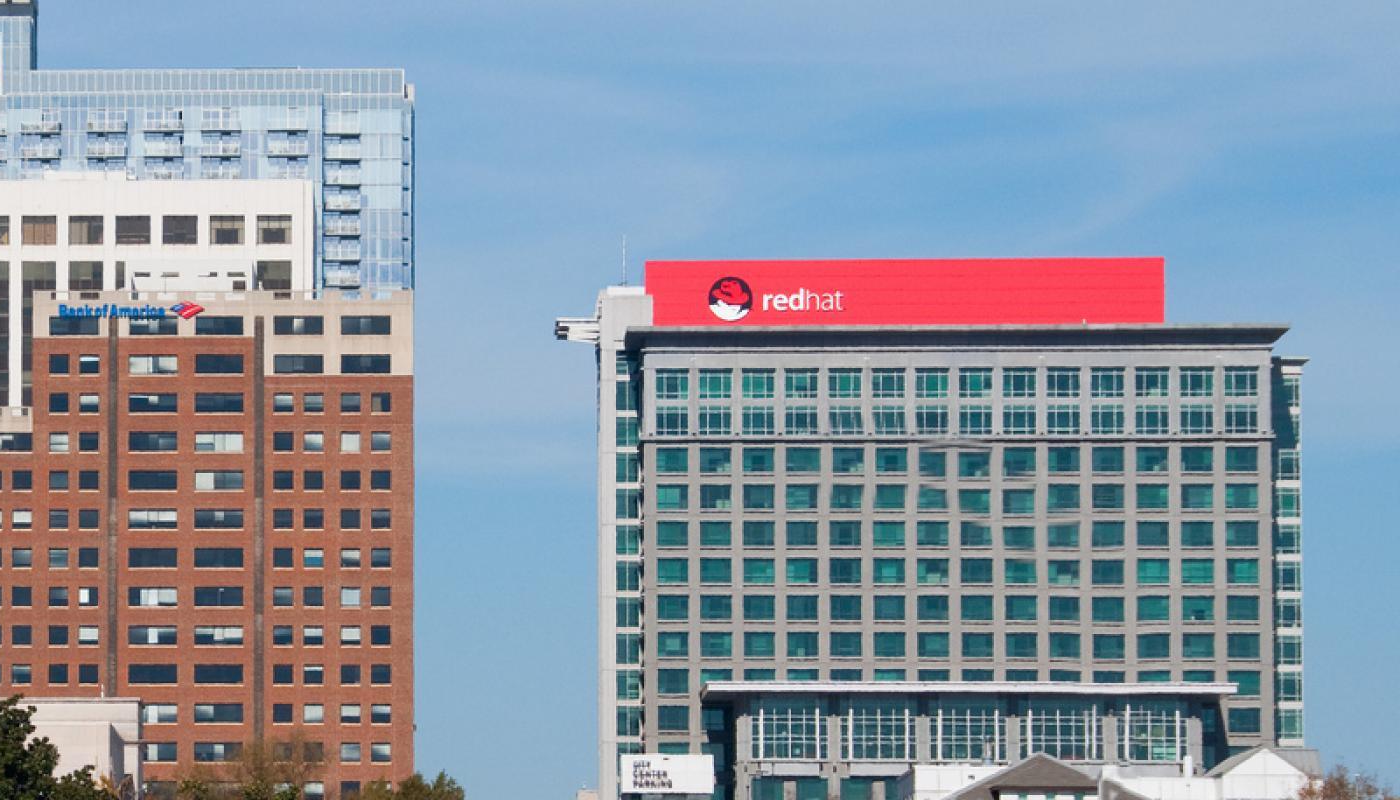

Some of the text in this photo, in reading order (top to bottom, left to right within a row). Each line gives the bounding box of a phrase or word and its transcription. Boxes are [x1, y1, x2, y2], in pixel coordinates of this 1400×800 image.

[58, 304, 165, 318] Bank of America
